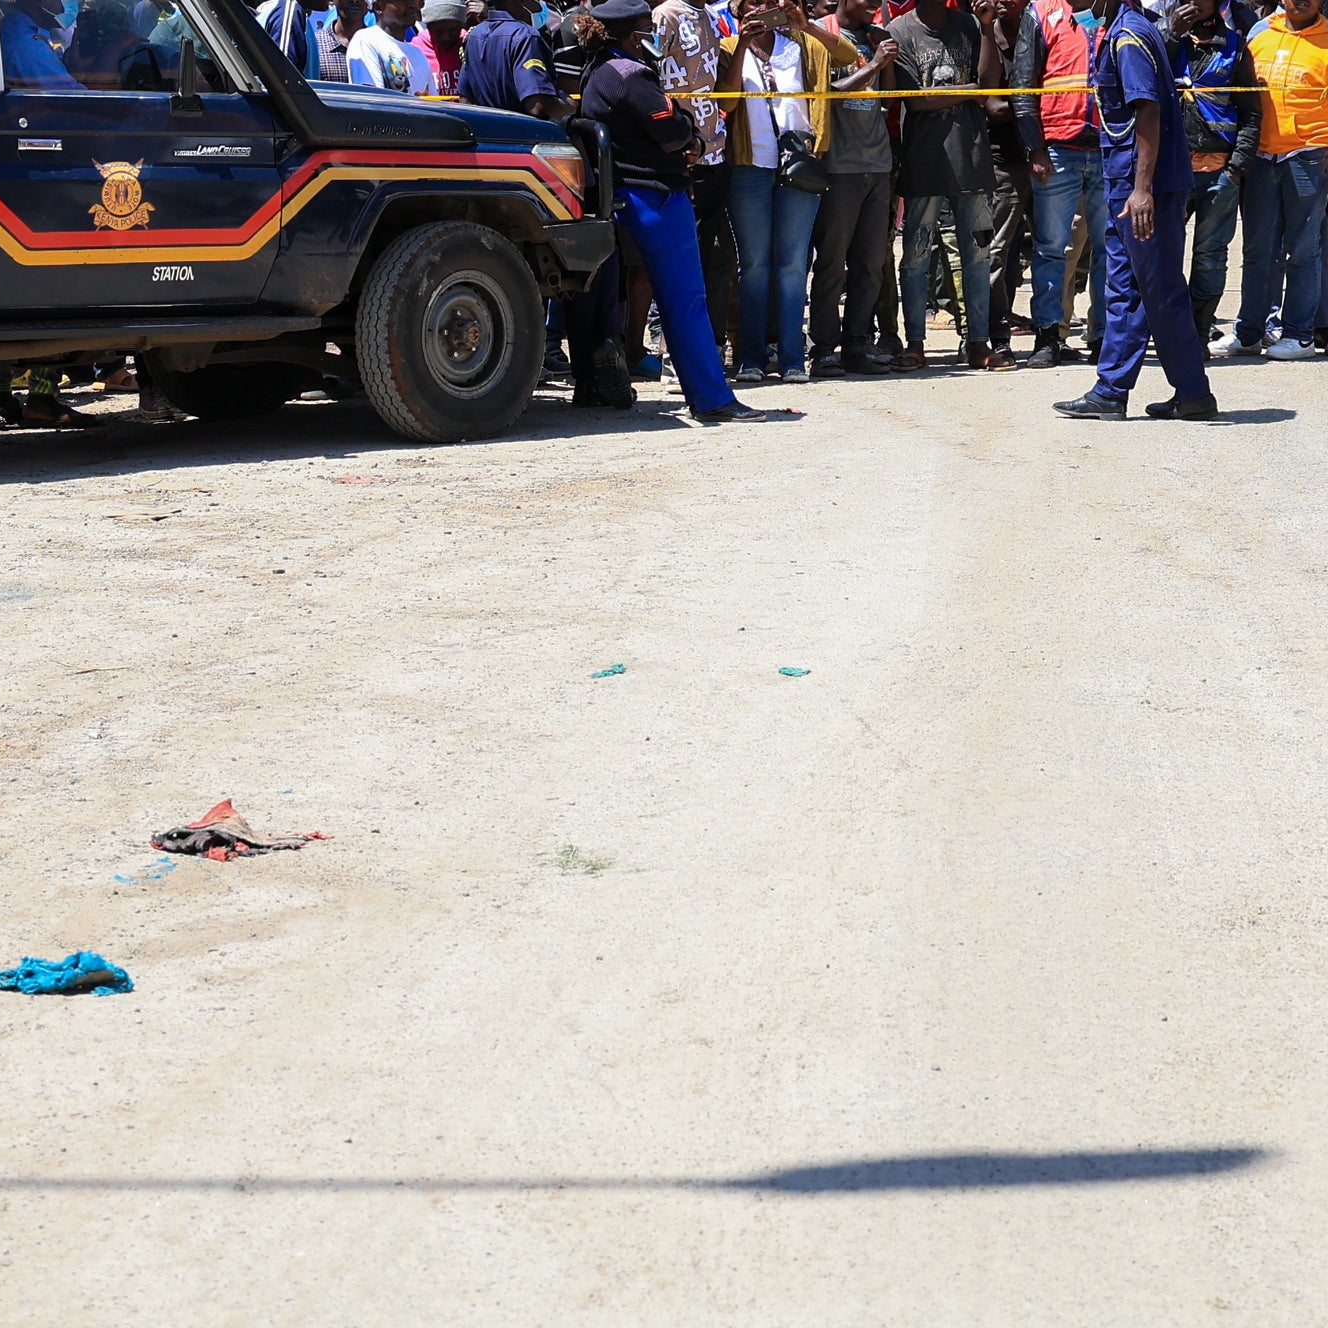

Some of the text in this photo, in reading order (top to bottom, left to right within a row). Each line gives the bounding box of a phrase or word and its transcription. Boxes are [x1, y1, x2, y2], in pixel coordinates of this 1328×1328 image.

[95, 209, 147, 228] KENYA POLICE
[151, 265, 195, 282] STATION
